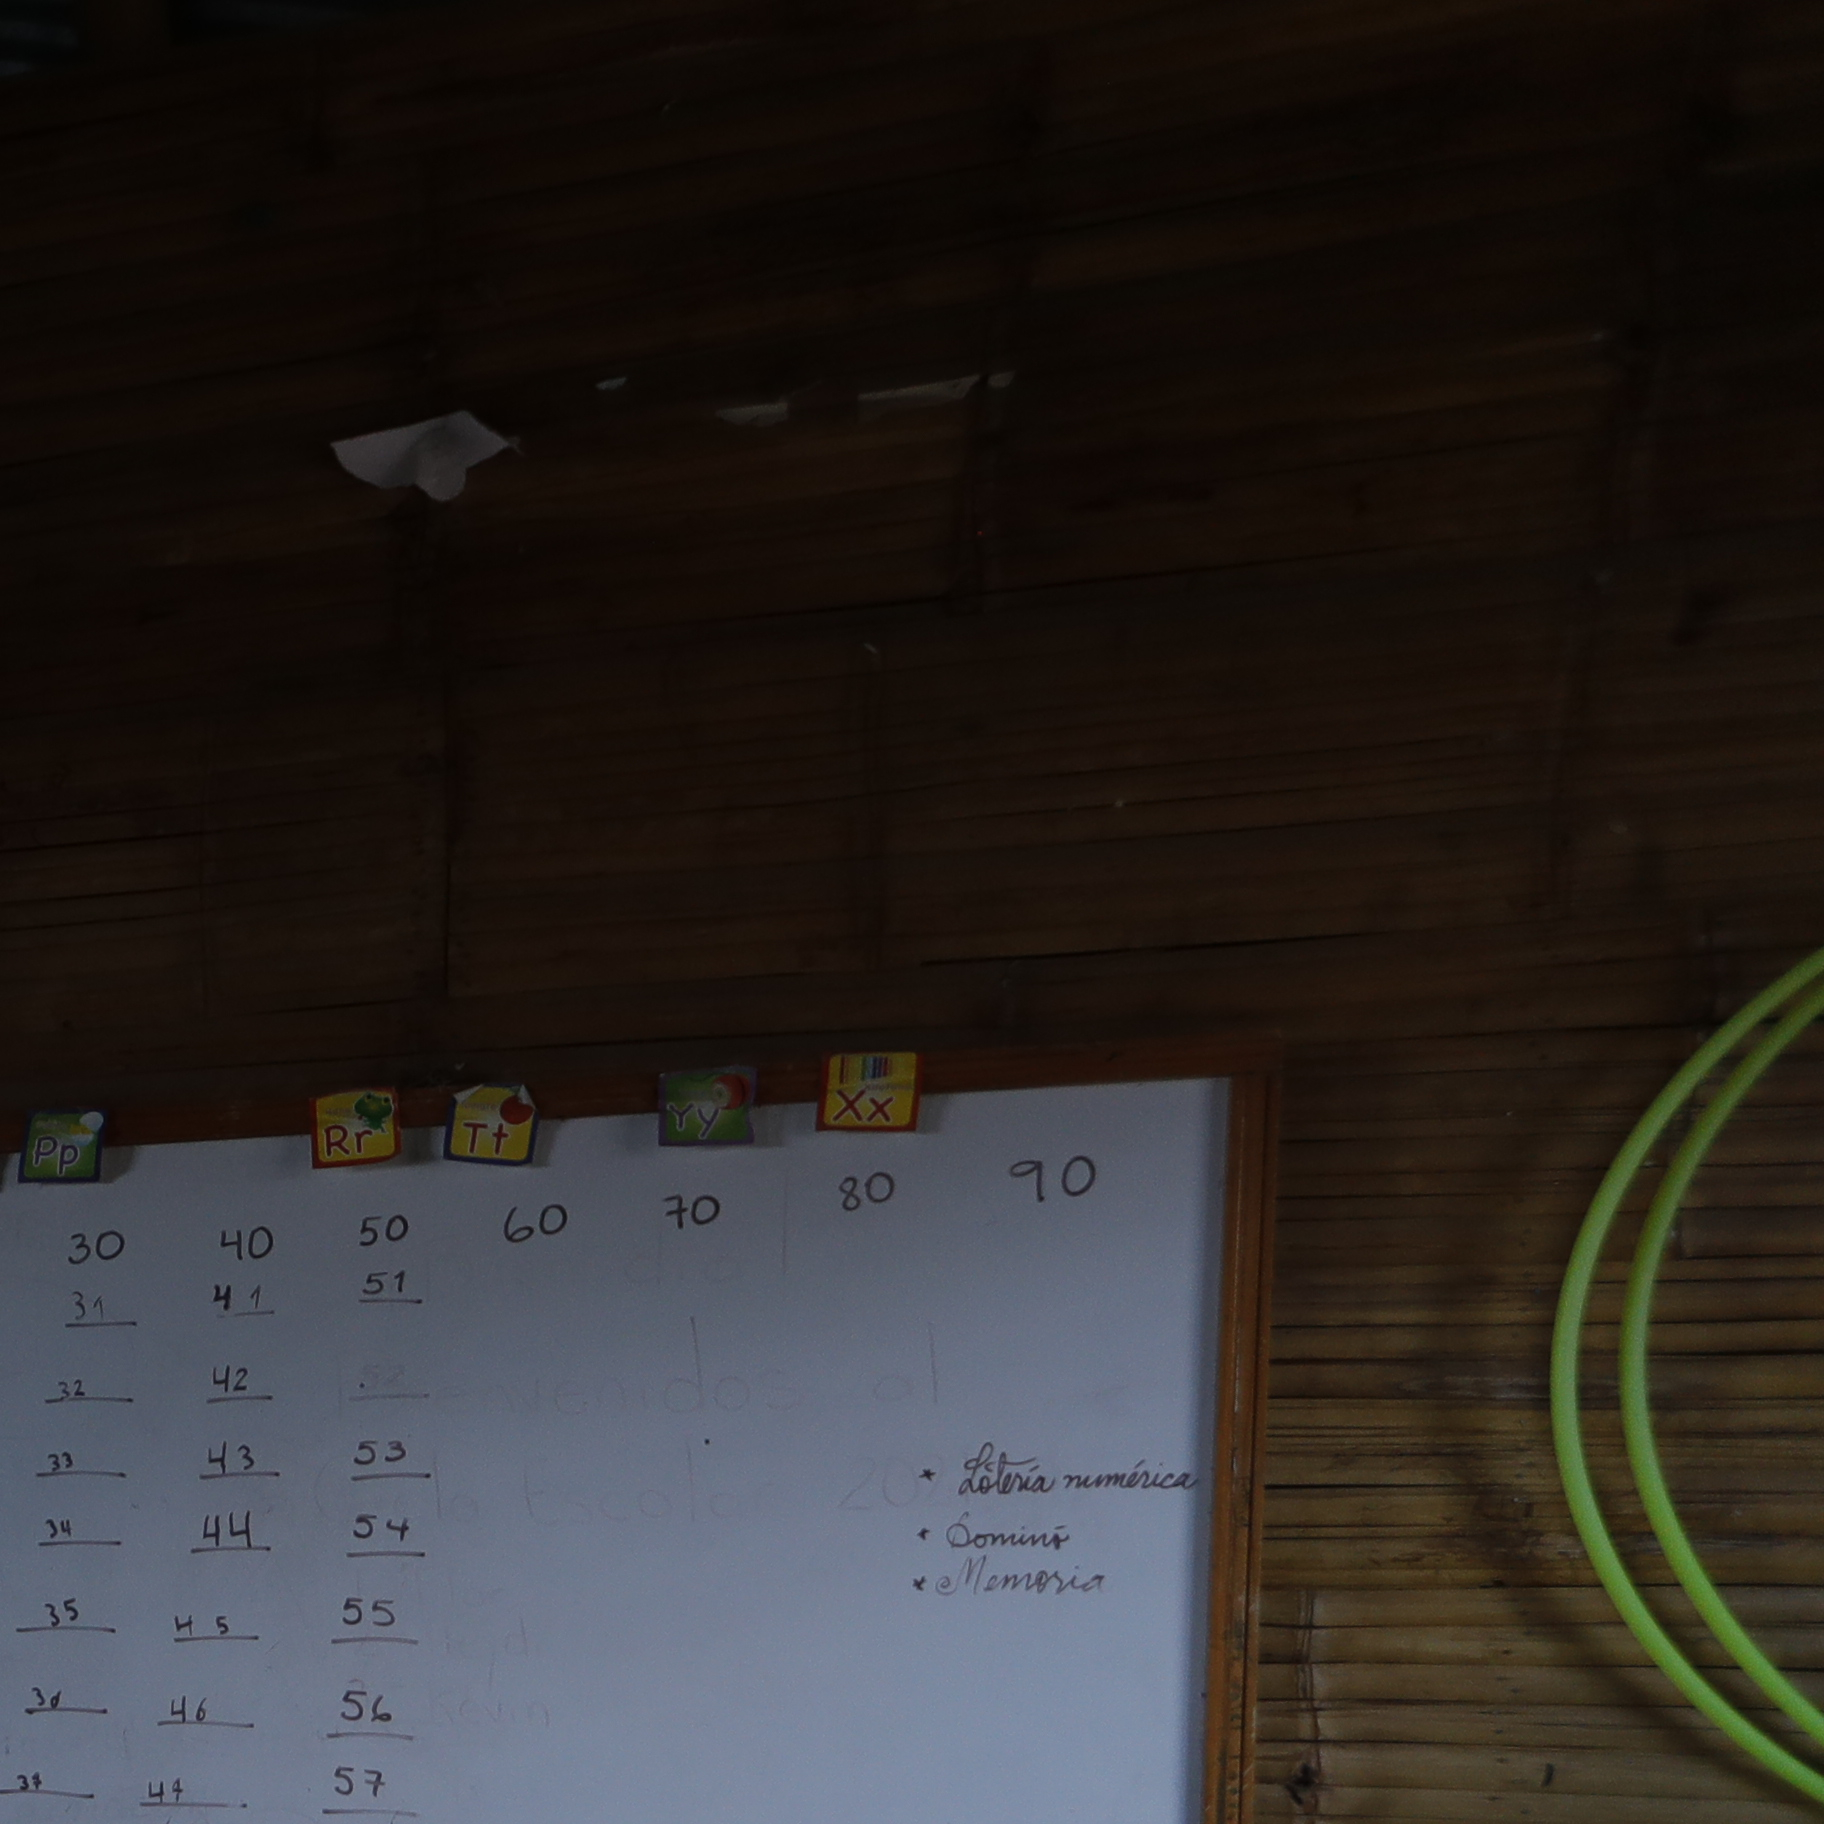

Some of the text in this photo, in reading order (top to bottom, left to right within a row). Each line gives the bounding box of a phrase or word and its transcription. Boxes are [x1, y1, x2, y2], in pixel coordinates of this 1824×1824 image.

[668, 1103, 720, 1138] Yy
[832, 1089, 894, 1122] Xx
[324, 1124, 373, 1156] Rr
[463, 1122, 509, 1154] Tt
[34, 1136, 79, 1175] Pp
[67, 1230, 125, 1265] 30
[220, 1226, 273, 1260] 40
[360, 1214, 408, 1246] 50
[504, 1203, 567, 1243] 60
[665, 1194, 720, 1230] 70
[838, 1171, 895, 1211] 80
[1010, 1154, 1096, 1202] 90
[73, 1291, 104, 1320] 31
[362, 1270, 405, 1294] 51
[58, 1379, 86, 1399] 32
[212, 1365, 249, 1392] 42
[48, 1453, 74, 1472] 33
[208, 1441, 254, 1474] 43
[353, 1440, 407, 1465] 53
[1063, 1459, 1200, 1490] numérica
[45, 1519, 71, 1538] 34
[202, 1509, 252, 1548] 44
[352, 1514, 410, 1541] 54
[46, 1599, 79, 1626] 35
[341, 1598, 396, 1627] 55
[170, 1695, 207, 1722] 46
[340, 1690, 392, 1722] 56
[17, 1773, 42, 1790] 37
[149, 1777, 183, 1801] 47
[334, 1766, 385, 1797] 57
